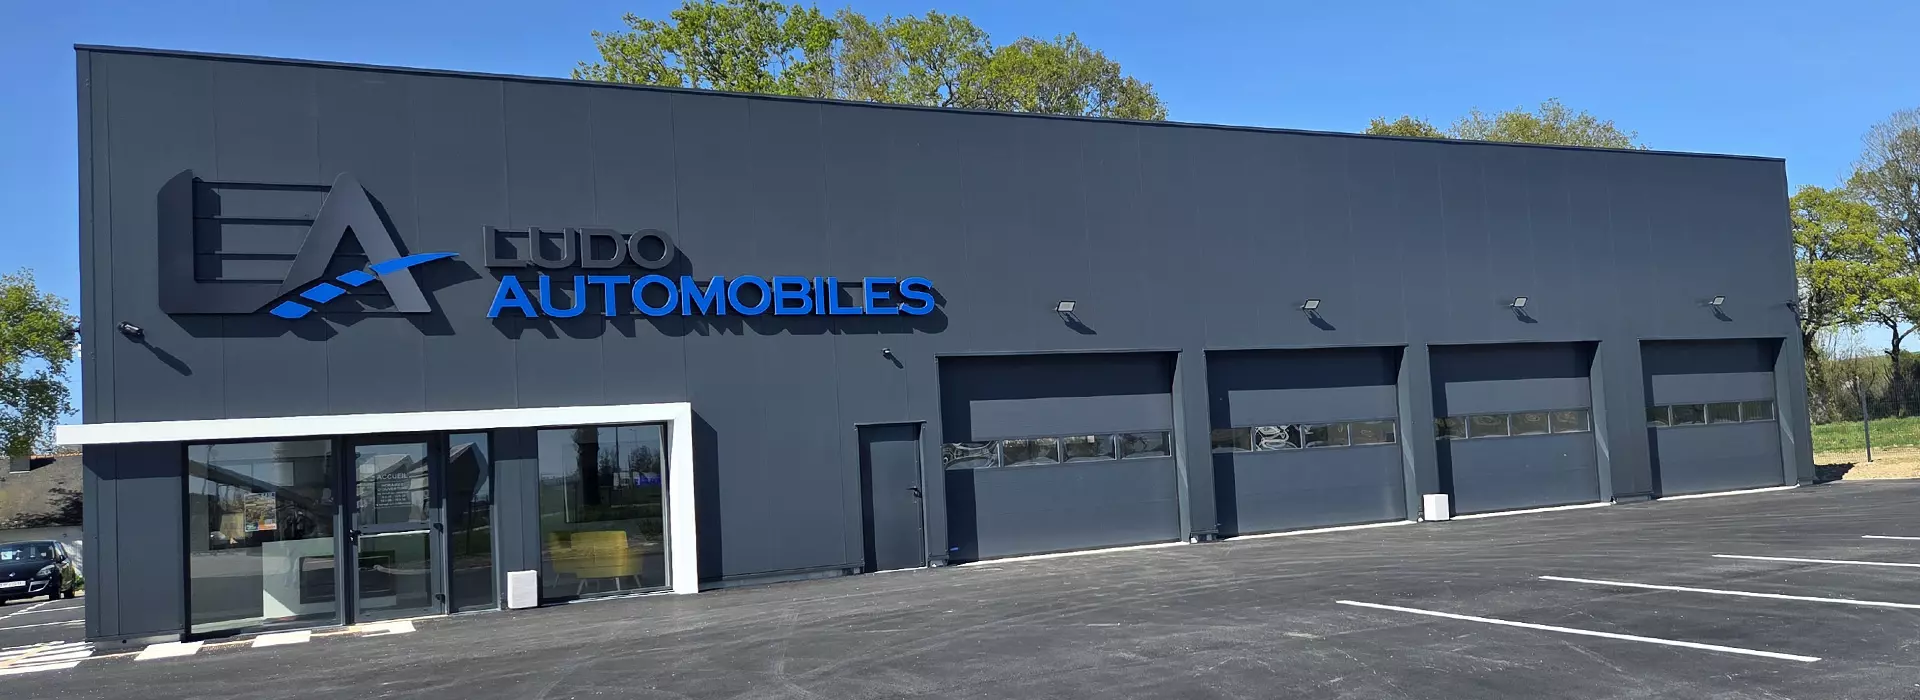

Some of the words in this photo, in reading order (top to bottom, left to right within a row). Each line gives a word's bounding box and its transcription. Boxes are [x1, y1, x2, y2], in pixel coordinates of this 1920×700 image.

[482, 225, 675, 269] LUDO
[486, 275, 936, 319] AUTOMOBILES
[376, 472, 408, 480] ACCUEIL
